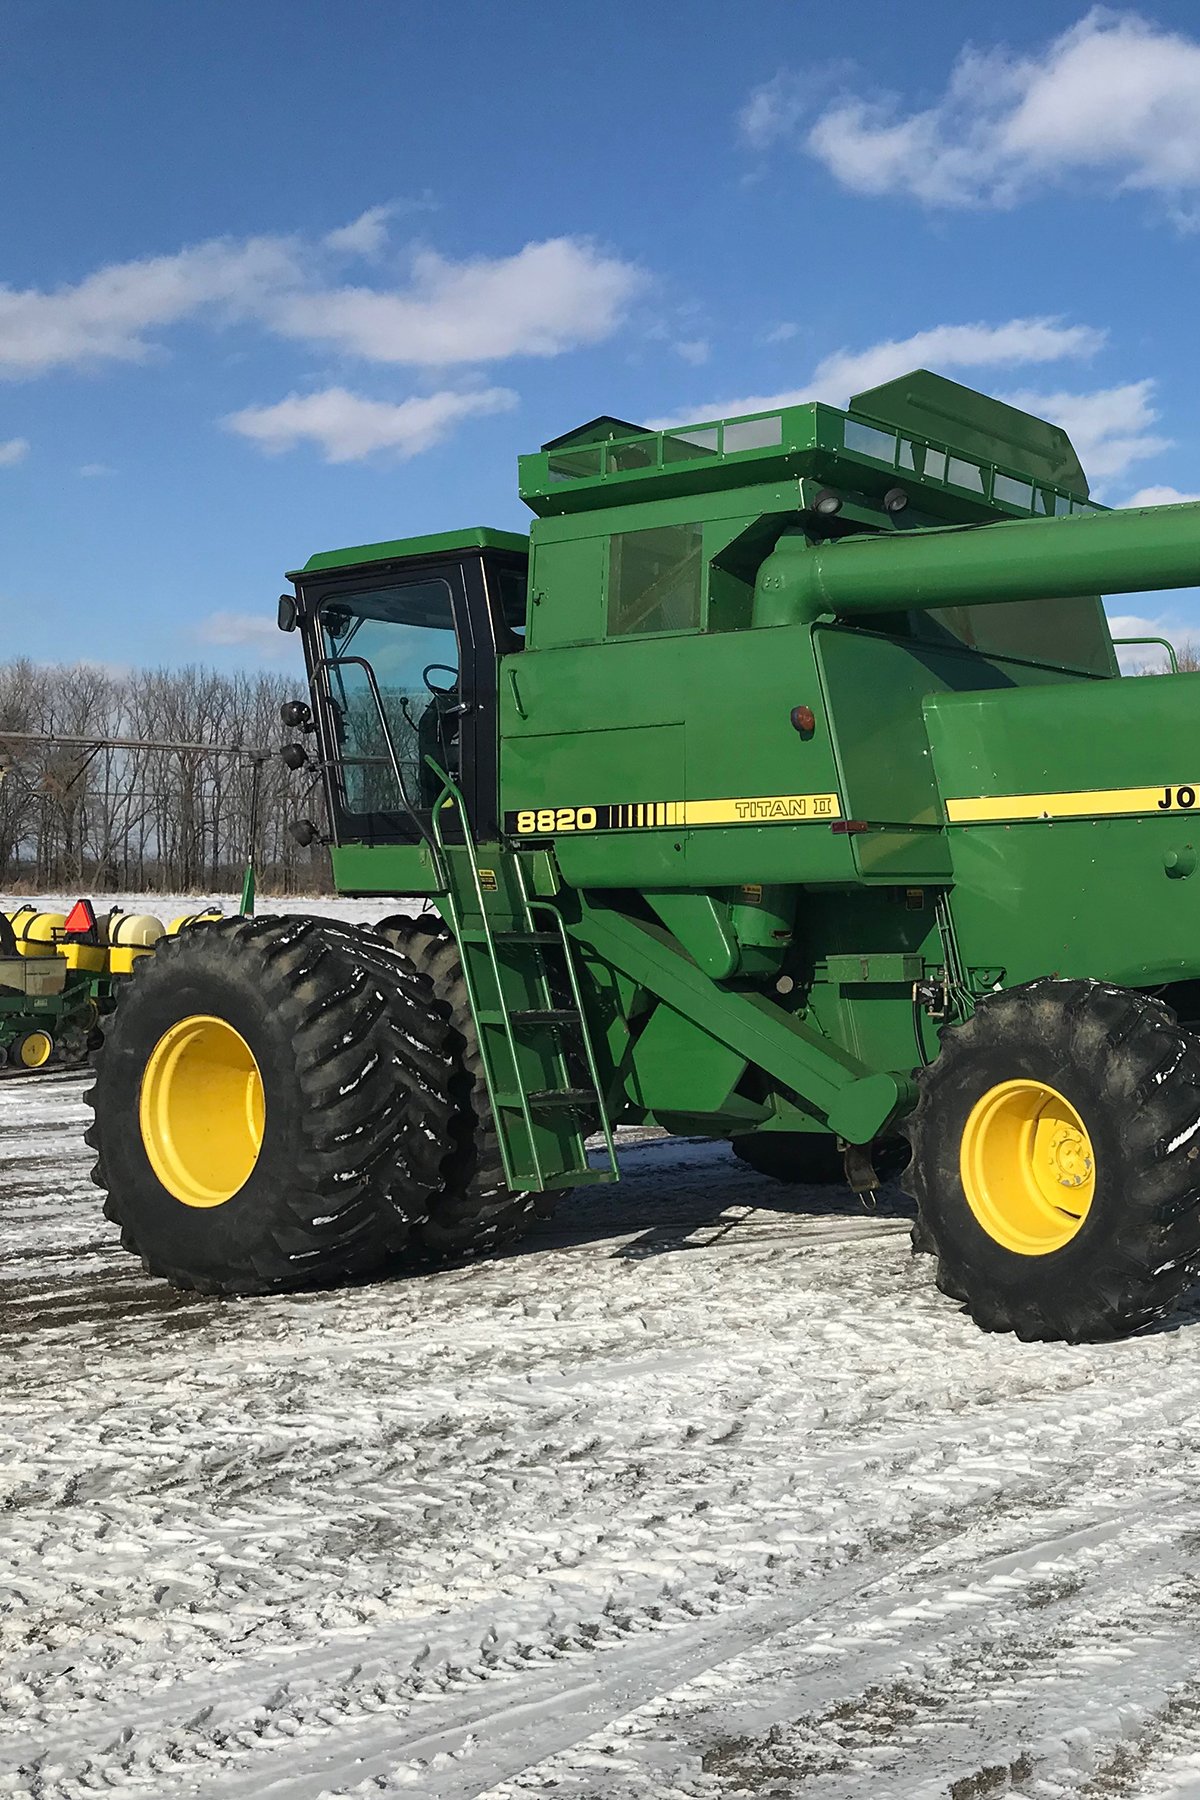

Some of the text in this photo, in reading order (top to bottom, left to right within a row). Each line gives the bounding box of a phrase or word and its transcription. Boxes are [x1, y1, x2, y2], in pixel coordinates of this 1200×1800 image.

[735, 798, 832, 818] TITAN II
[517, 807, 597, 833] 8820
